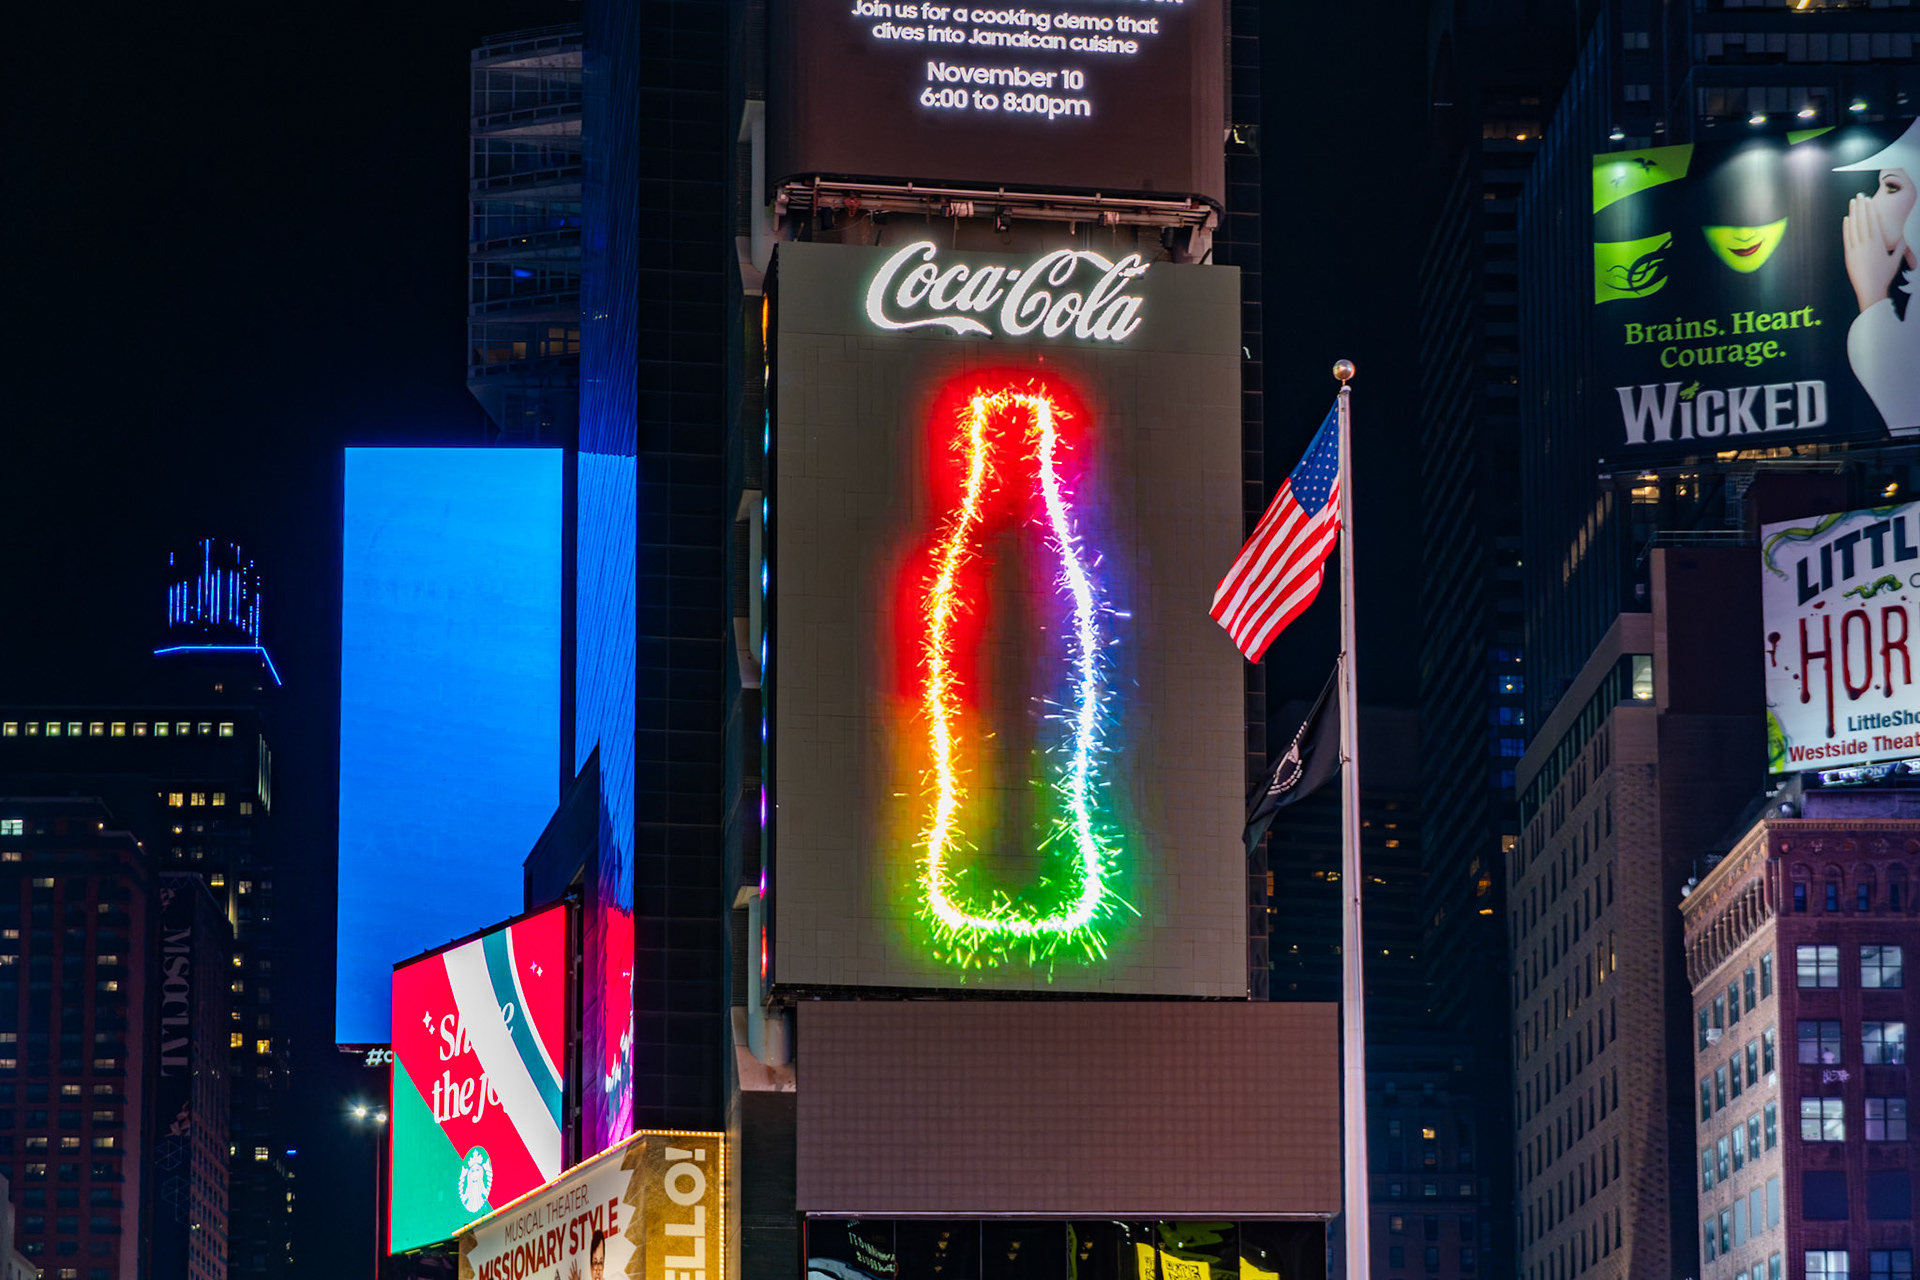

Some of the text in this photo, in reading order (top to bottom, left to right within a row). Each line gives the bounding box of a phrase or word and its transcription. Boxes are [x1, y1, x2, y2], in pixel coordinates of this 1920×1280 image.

[851, 0, 1159, 34] Join us for a cooking demo that
[872, 22, 1138, 54] dives into Jamaican cuisine
[927, 61, 1084, 90] November 10
[920, 87, 1091, 120] 6:00 to 8:00pm
[866, 241, 1150, 341] Coca-Cola
[1624, 305, 1823, 346] Brains. Heart.
[1660, 340, 1787, 369] Courage.
[1796, 512, 1920, 608] LITTL
[1799, 602, 1920, 739] HOR
[1789, 739, 1868, 763] Westside
[439, 1002, 515, 1061] She
[432, 1069, 508, 1124] the jo
[505, 1207, 544, 1246] MUSICAL
